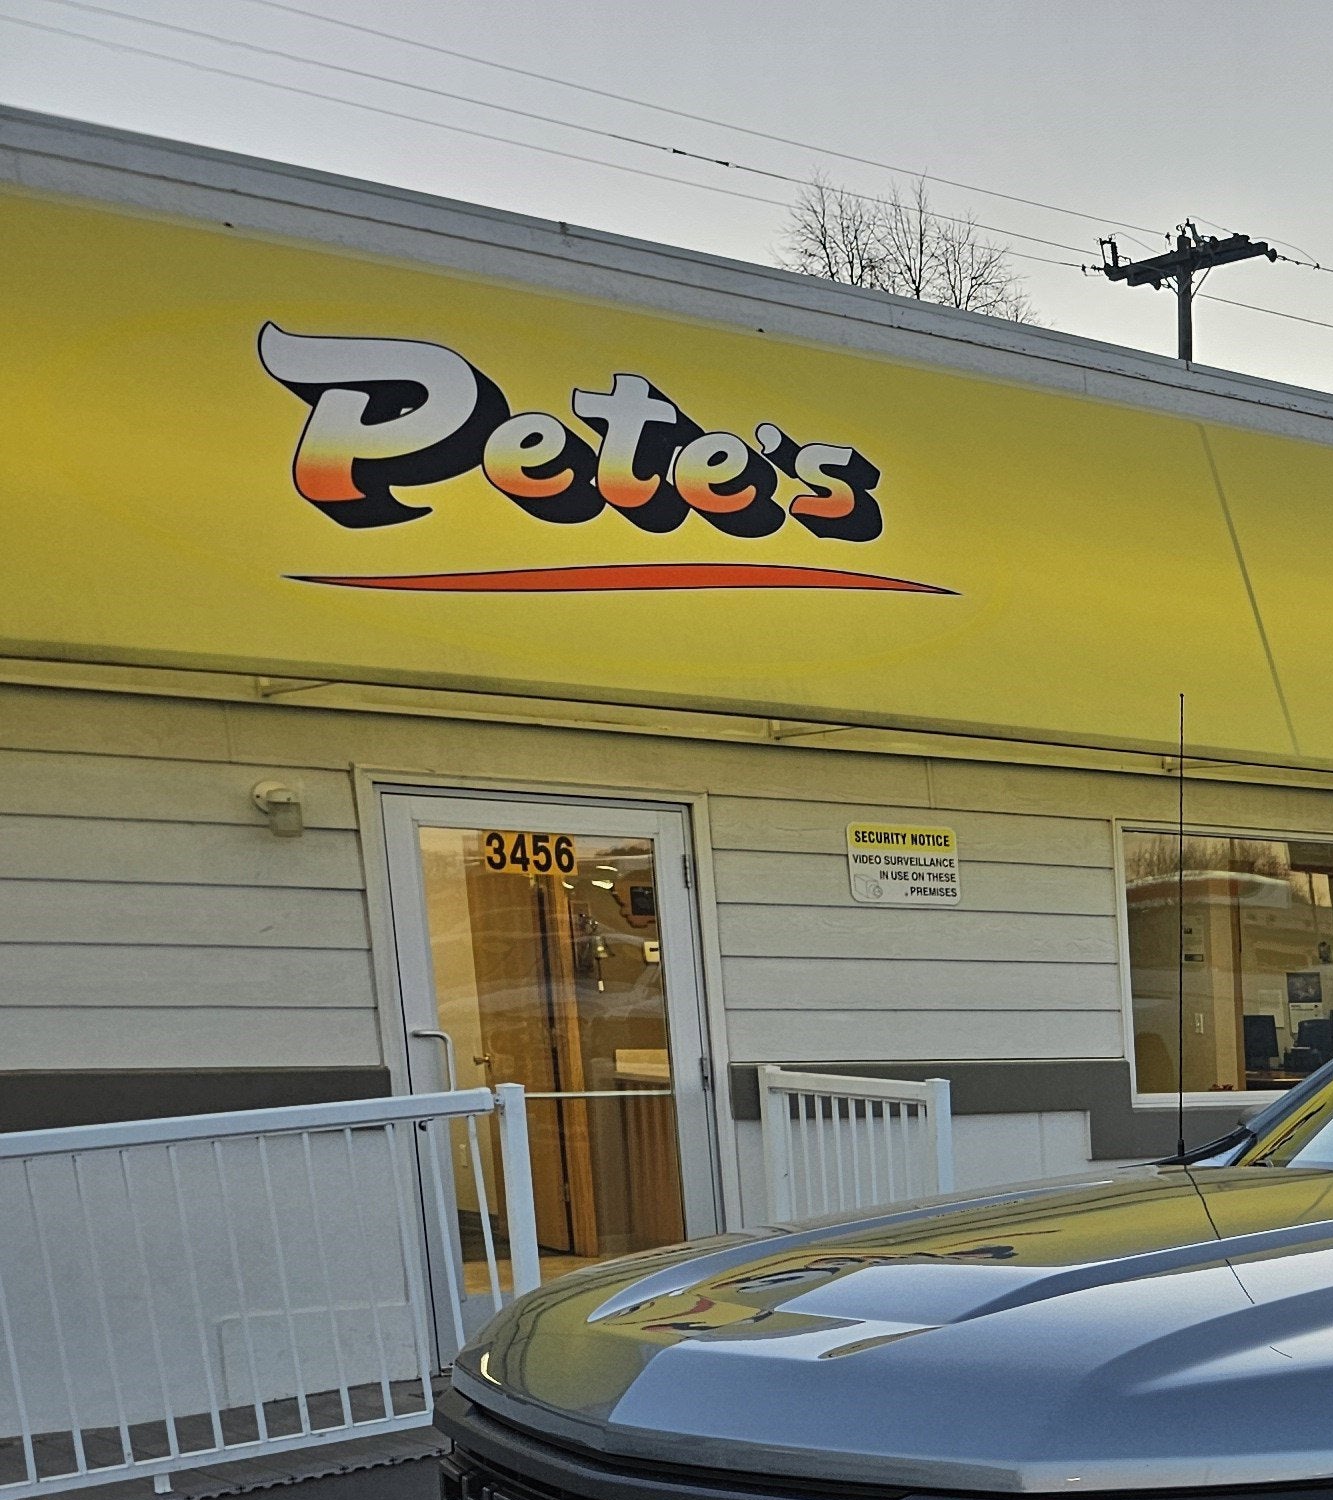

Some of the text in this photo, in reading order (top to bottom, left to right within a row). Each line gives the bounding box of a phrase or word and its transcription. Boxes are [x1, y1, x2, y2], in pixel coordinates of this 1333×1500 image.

[258, 321, 882, 542] Pete's
[854, 830, 951, 848] SECURITY NOTICE
[485, 832, 575, 874] 3456
[852, 854, 955, 868] VIDEO SURVEILLANCE
[879, 870, 957, 883] IN USE ON THESE
[909, 886, 958, 898] PREMISES
